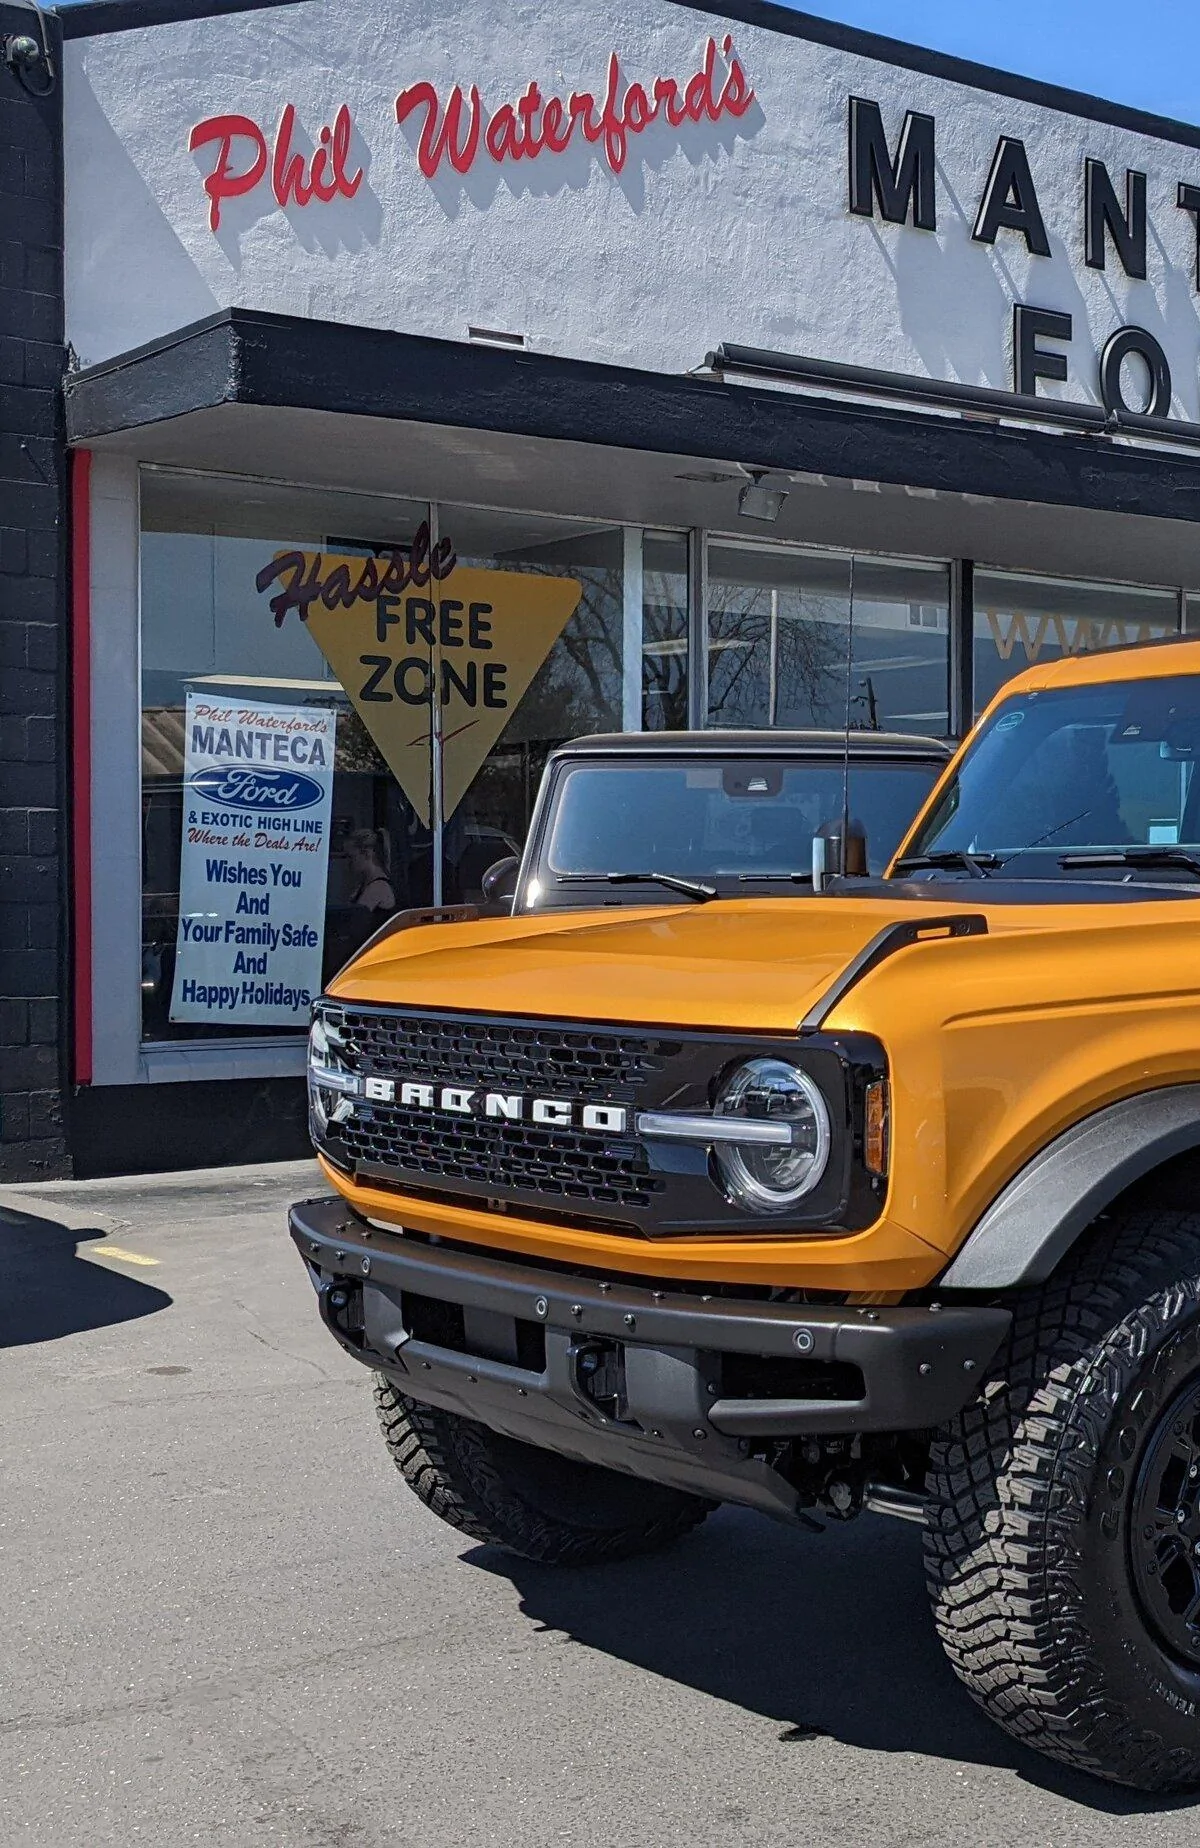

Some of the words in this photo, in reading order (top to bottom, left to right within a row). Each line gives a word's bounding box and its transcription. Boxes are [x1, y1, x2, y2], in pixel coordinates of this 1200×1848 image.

[188, 104, 363, 232] Phil
[396, 34, 755, 175] Waterford's
[256, 520, 457, 628] Hassle
[376, 595, 493, 650] FREE
[359, 654, 508, 709] ZONE
[194, 704, 231, 723] Phil
[237, 709, 328, 734] Waterford's
[191, 725, 326, 766] MANTECA
[218, 769, 300, 804] Ford
[188, 811, 198, 824] &
[201, 811, 253, 828] EXOTIC
[187, 828, 229, 846] Where
[232, 834, 250, 847] the
[254, 833, 289, 850] Deals
[291, 838, 321, 852] Are!
[206, 859, 267, 886] Wishes
[270, 863, 302, 888] You
[236, 891, 270, 915] And
[181, 918, 222, 942] Your
[224, 920, 279, 951] Family
[282, 924, 318, 947] Safe
[232, 951, 267, 974] And
[182, 979, 239, 1010] Happy
[365, 1077, 627, 1132] BRONCO
